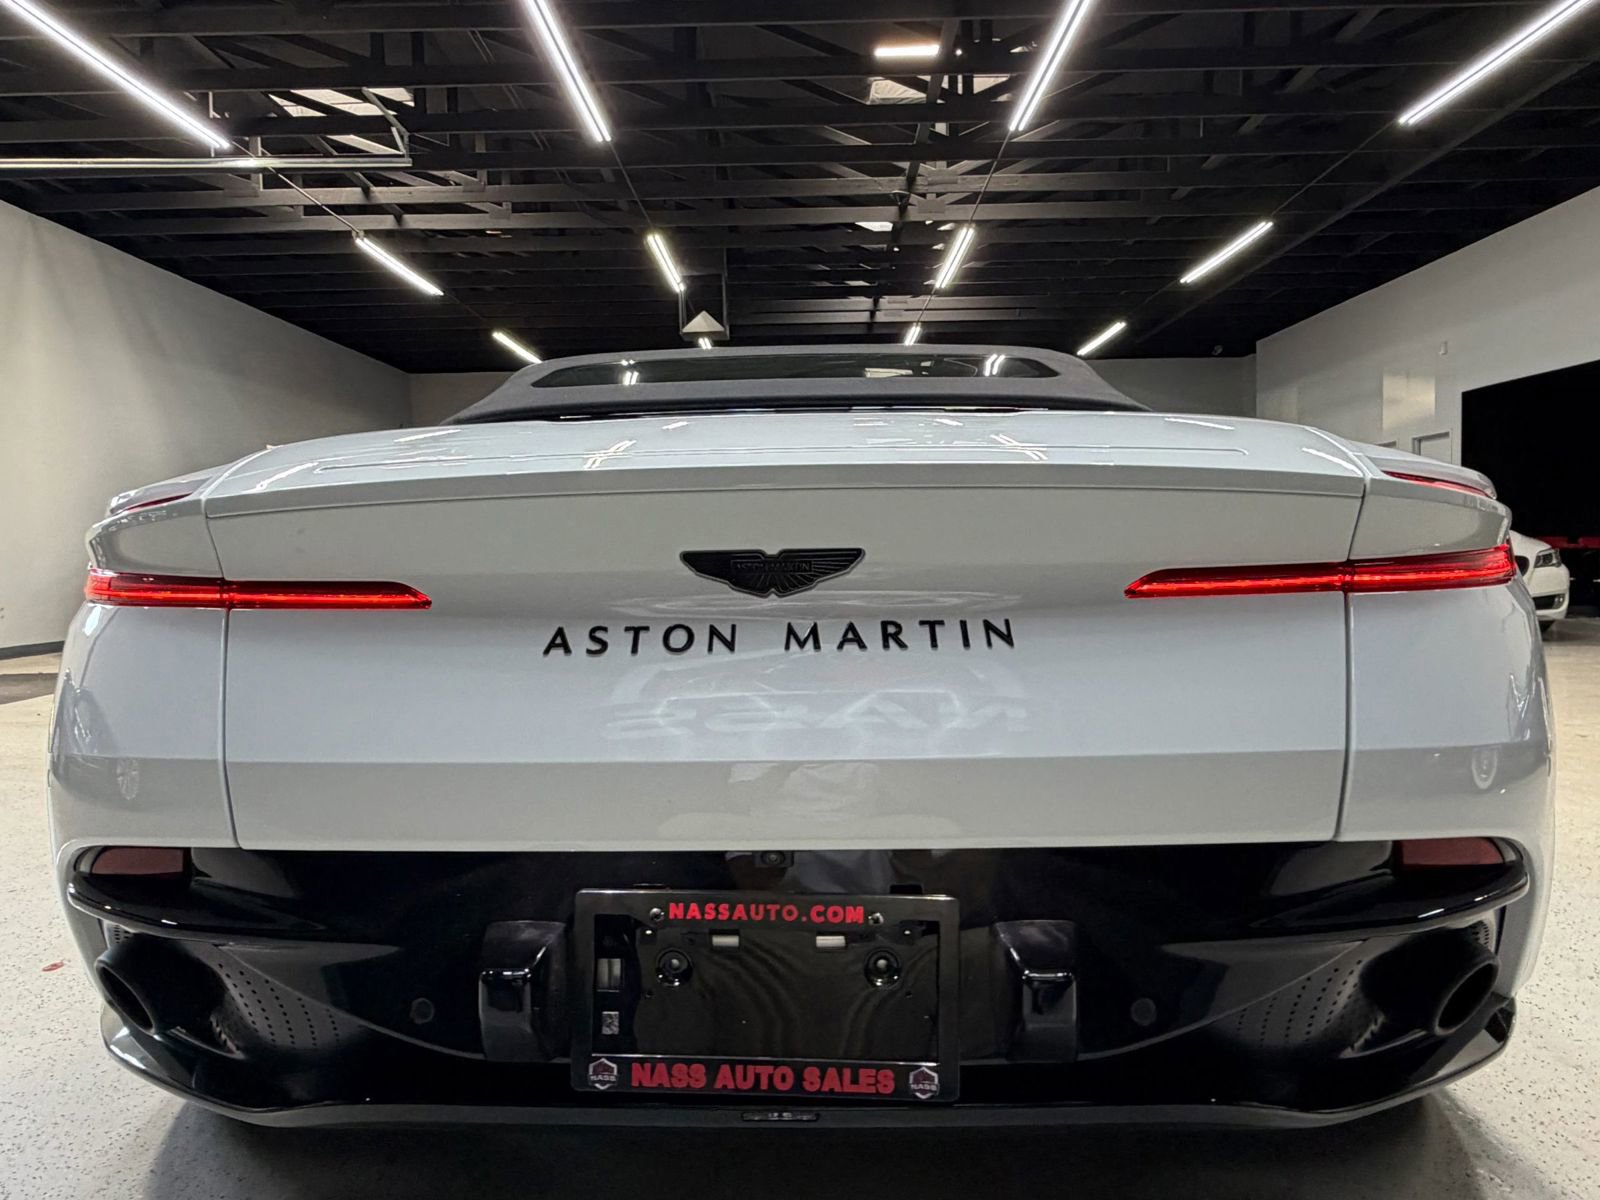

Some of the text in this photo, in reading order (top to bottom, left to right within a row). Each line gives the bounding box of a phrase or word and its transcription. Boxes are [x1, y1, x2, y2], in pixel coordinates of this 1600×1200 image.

[542, 618, 1016, 657] ASTON MARTIN
[668, 902, 865, 924] NASSAUTO.COM
[631, 1062, 896, 1095] NASS AUTO SALES
